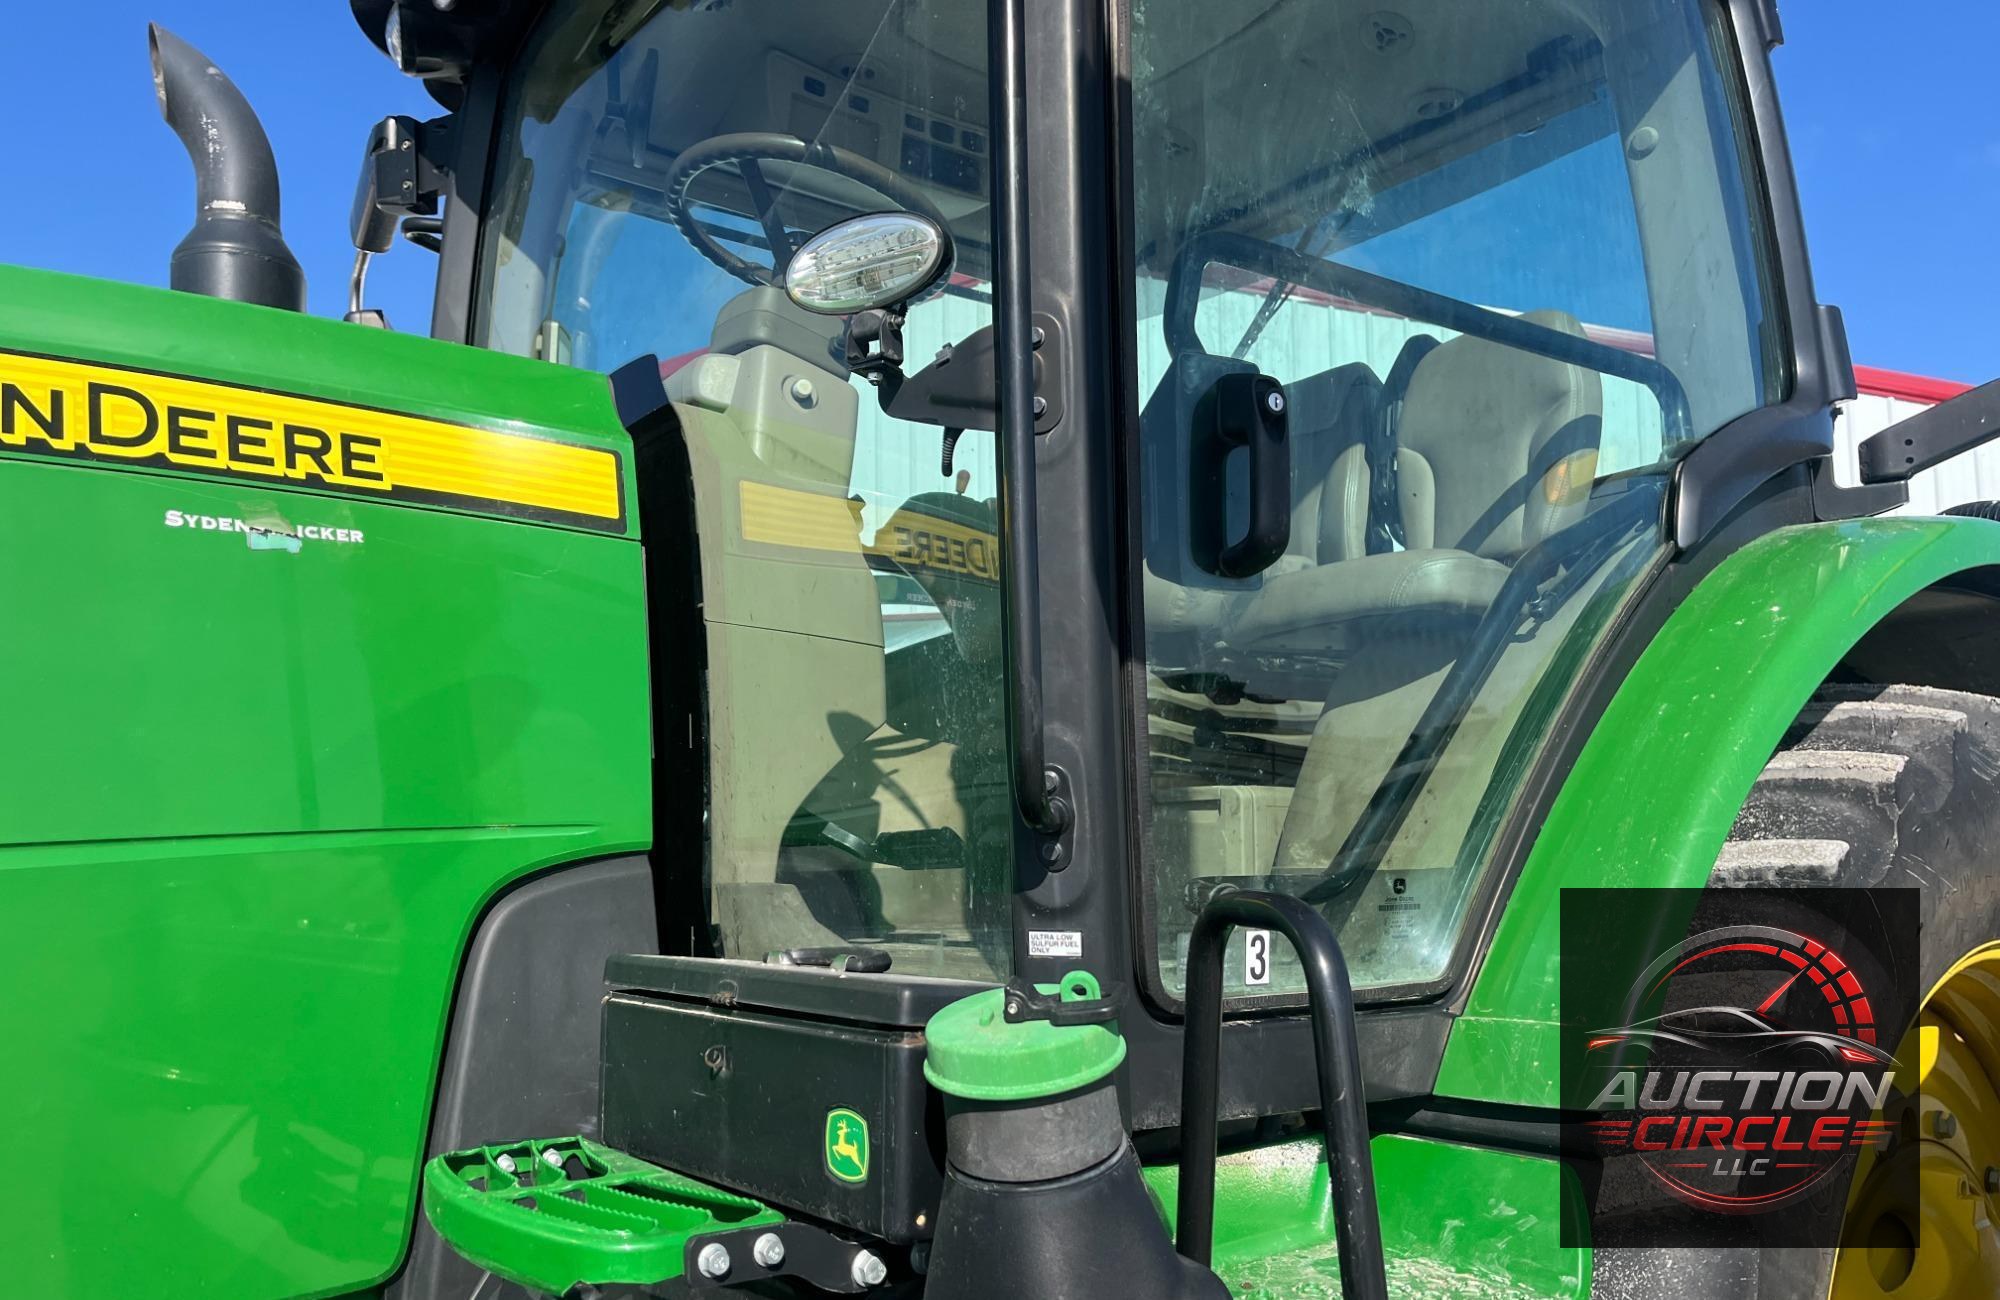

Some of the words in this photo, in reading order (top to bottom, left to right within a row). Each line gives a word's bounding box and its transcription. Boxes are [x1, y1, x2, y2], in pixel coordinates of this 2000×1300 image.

[88, 381, 385, 482] DEERE
[164, 509, 365, 544] SYDENICKER
[1250, 934, 1266, 981] 3
